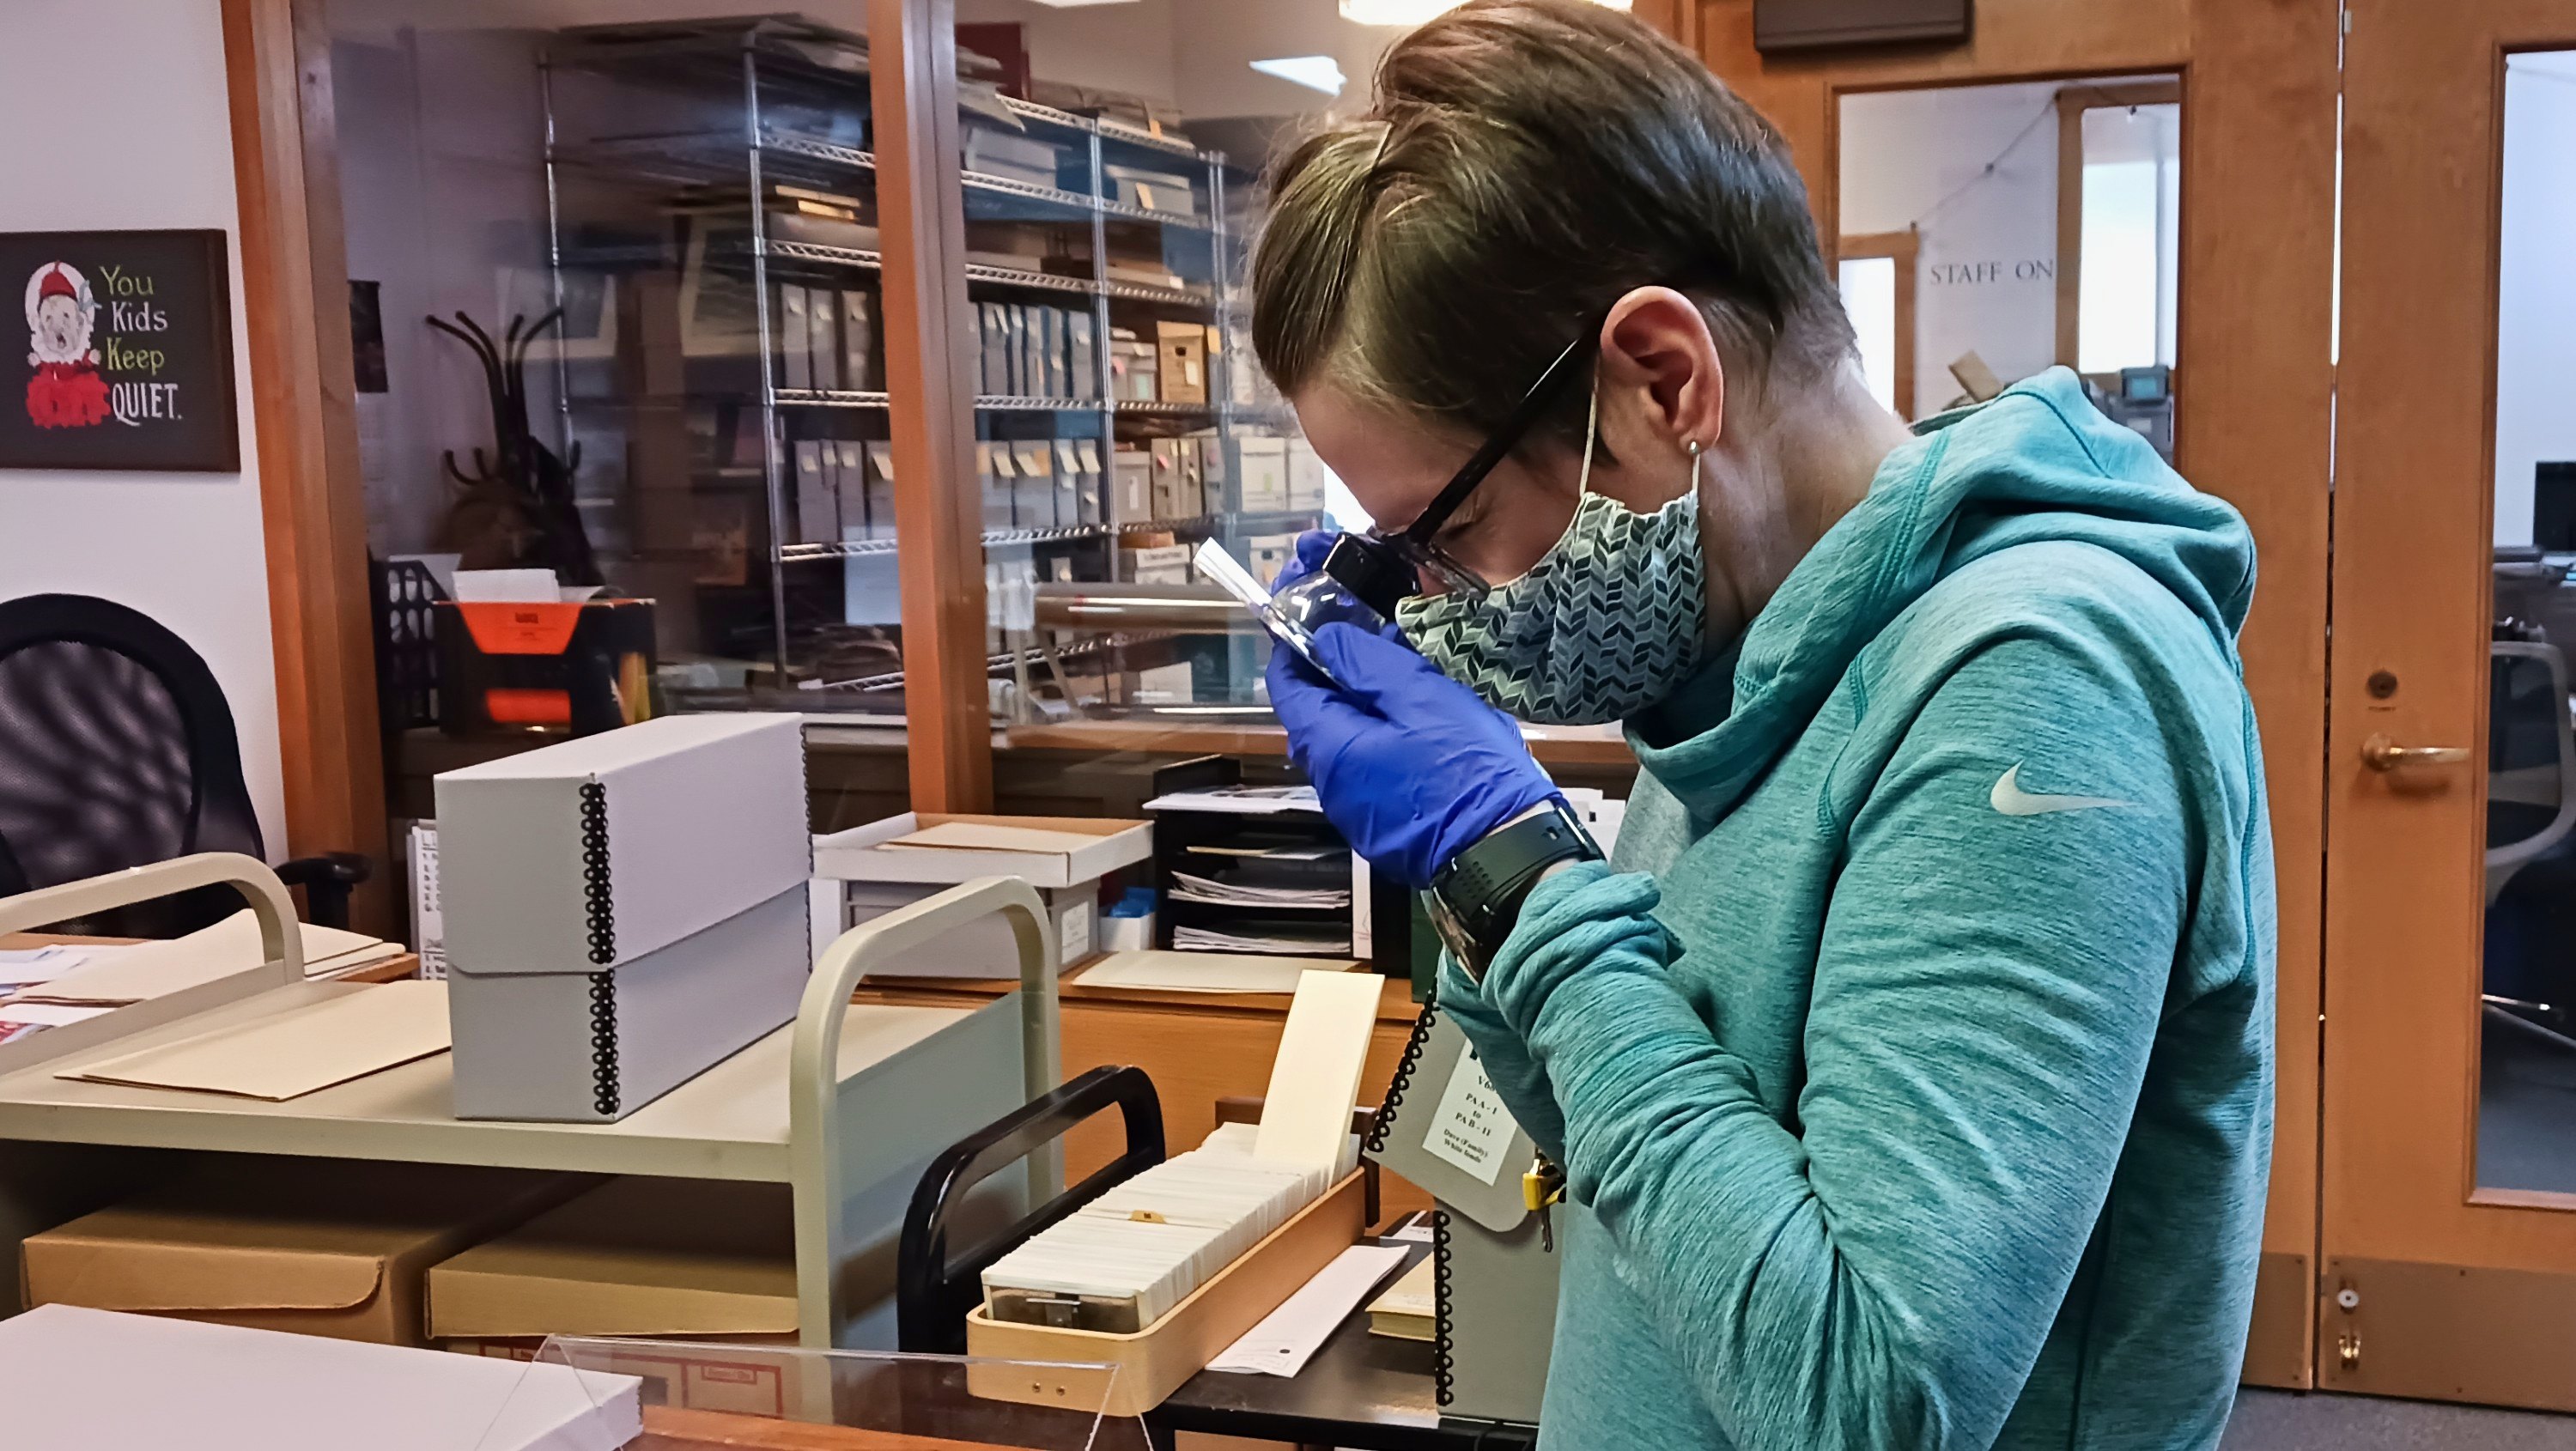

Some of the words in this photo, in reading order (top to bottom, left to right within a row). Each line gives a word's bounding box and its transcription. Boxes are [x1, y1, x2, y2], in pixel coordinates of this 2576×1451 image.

[99, 264, 154, 296] You
[1931, 261, 2002, 284] STAFF
[2015, 259, 2053, 280] ON
[112, 301, 168, 332] Kids
[106, 337, 165, 376] Keep
[112, 382, 183, 426] QUIET.
[1473, 1110, 1481, 1119] to
